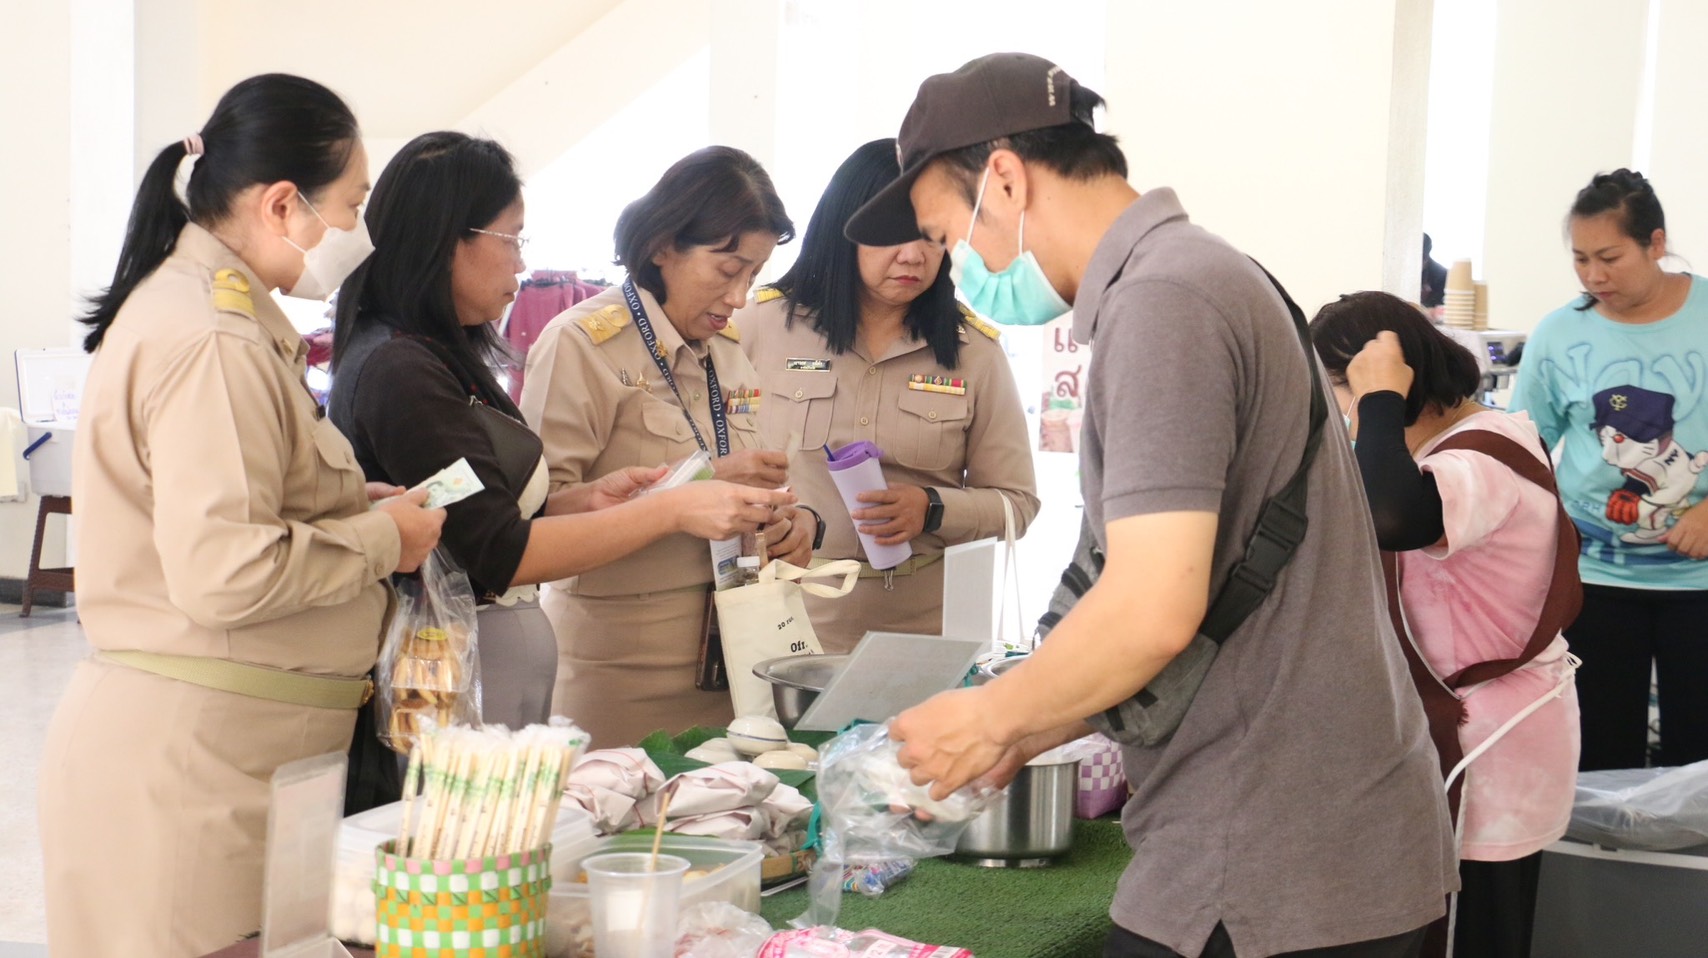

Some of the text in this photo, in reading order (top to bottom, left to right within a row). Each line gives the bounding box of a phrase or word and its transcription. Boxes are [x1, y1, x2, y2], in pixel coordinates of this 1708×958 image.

[709, 370, 728, 458] OXFORD OXFOR
[777, 622, 786, 630] 20
